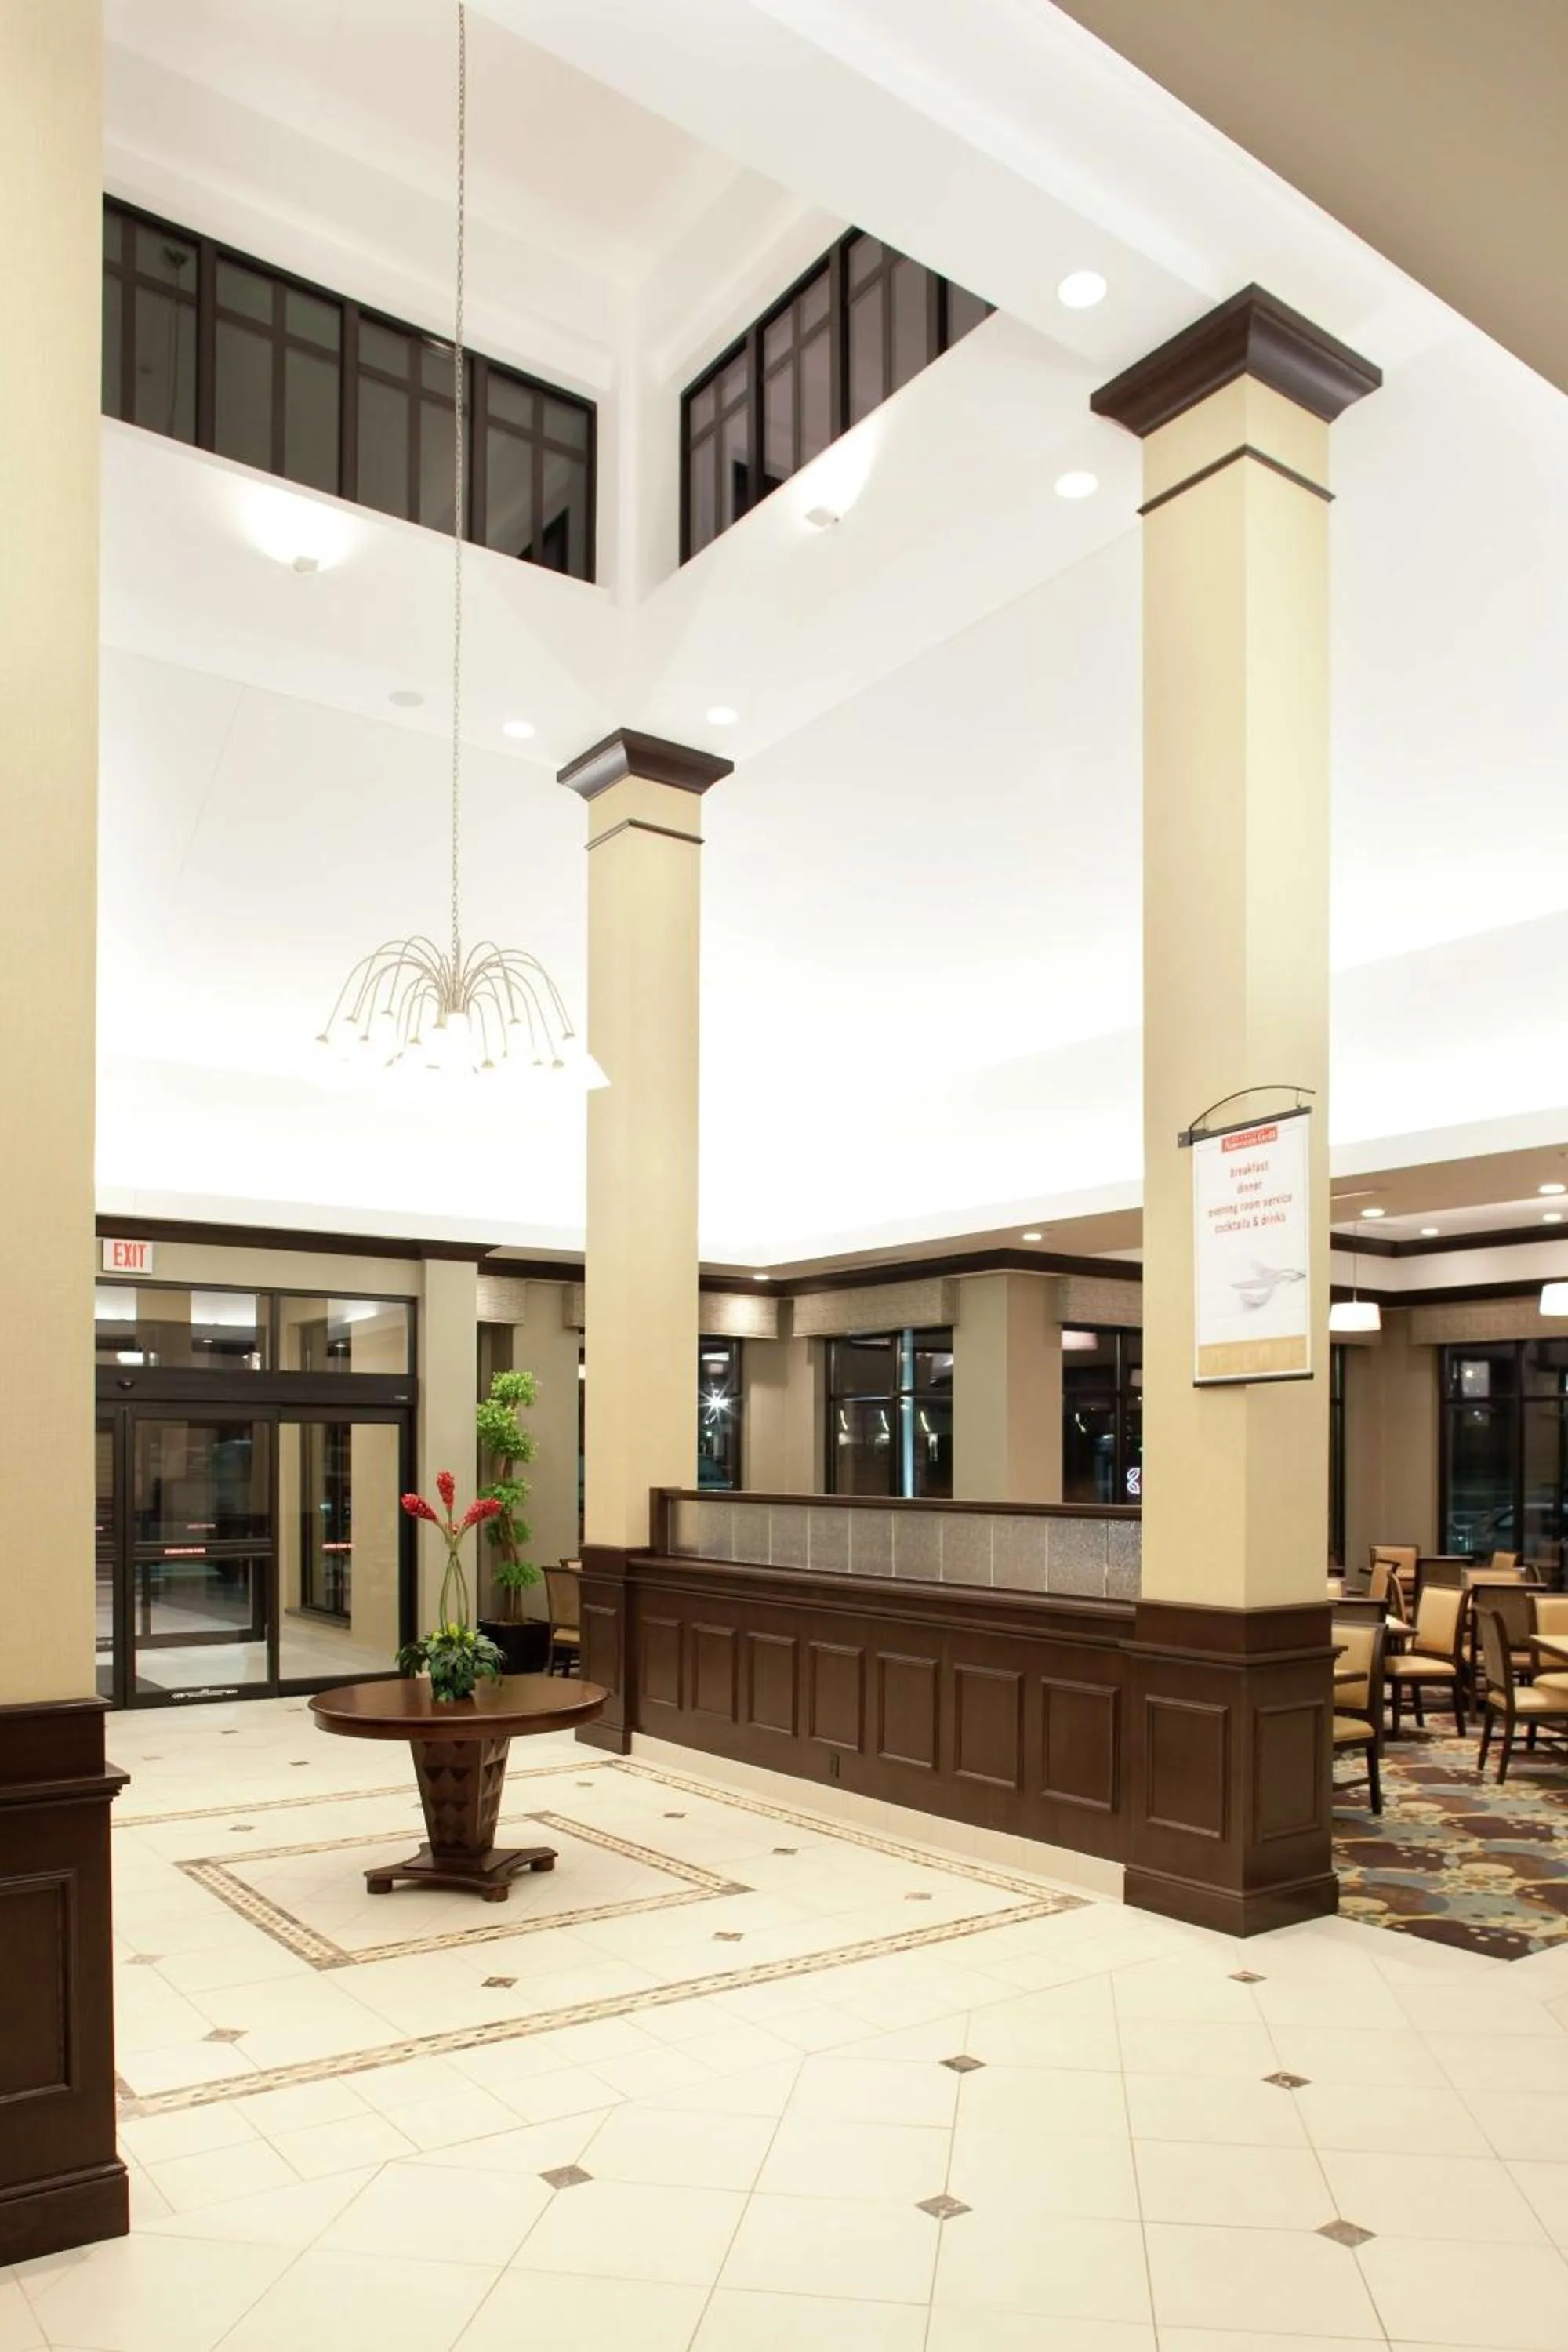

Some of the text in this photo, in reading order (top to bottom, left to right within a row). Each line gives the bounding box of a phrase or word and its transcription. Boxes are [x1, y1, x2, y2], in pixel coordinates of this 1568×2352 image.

[1230, 1160, 1269, 1178] breakfast
[1236, 1181, 1263, 1194] dinner
[1208, 1194, 1293, 1217] evening room service
[1214, 1213, 1286, 1233] cocktails & drinks
[114, 1242, 147, 1268] EXIT
